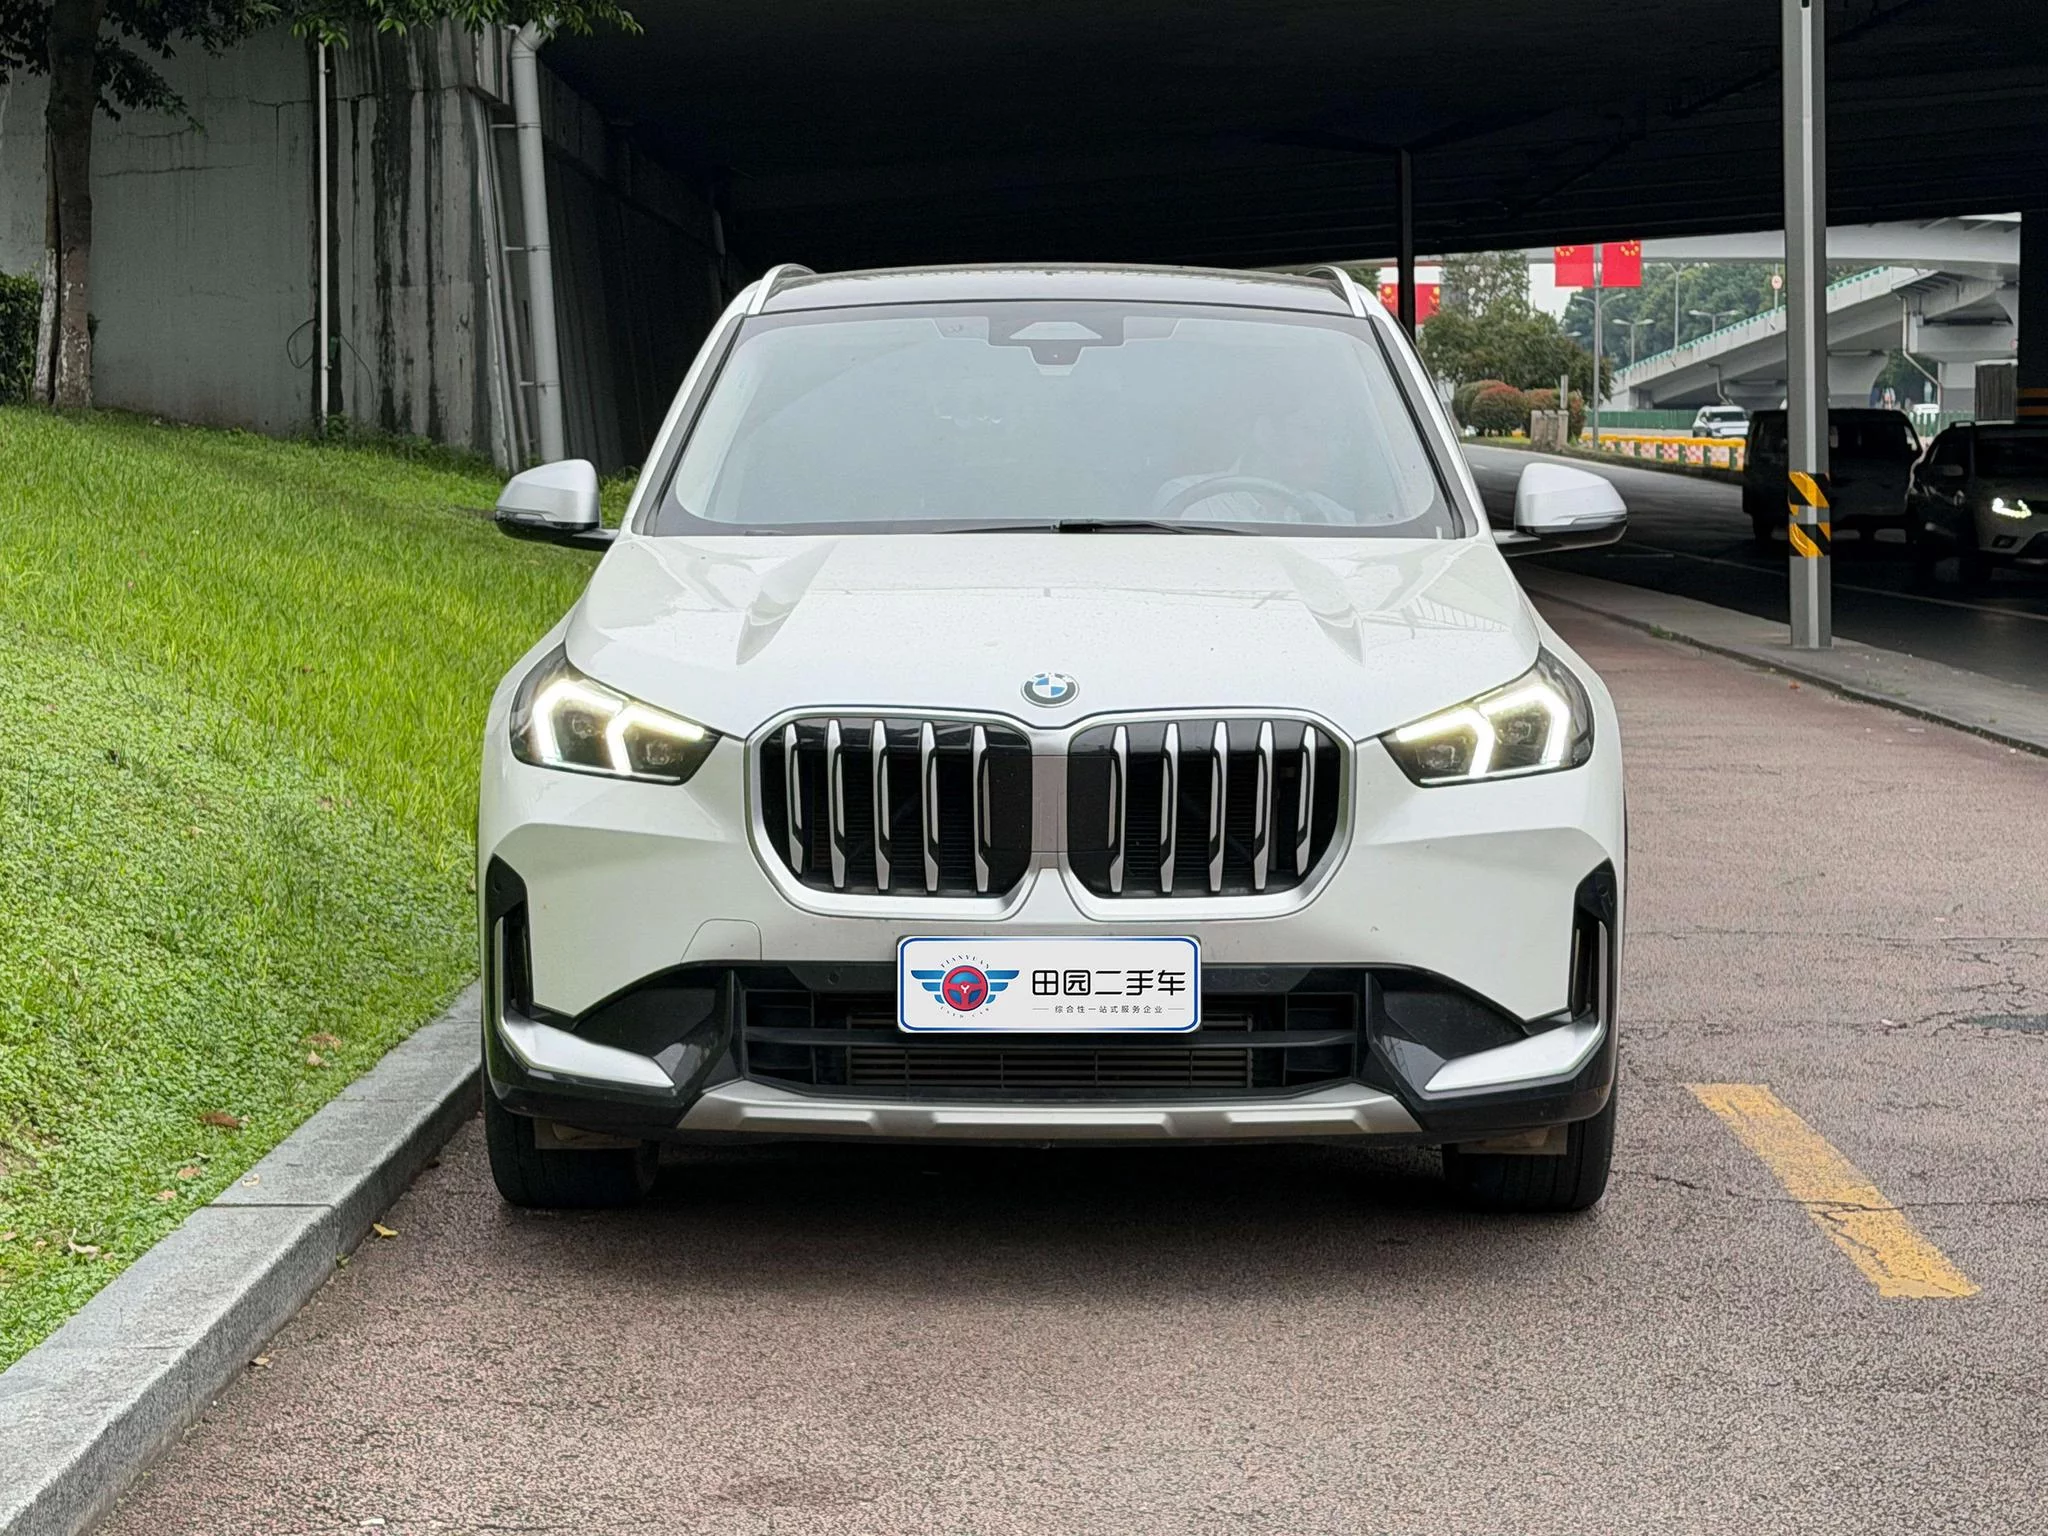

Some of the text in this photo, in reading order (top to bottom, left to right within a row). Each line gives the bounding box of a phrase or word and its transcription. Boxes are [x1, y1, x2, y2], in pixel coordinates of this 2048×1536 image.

[1032, 969, 1186, 996] 田园二手车
[1054, 1004, 1163, 1014] 综合性一站式服务企业
